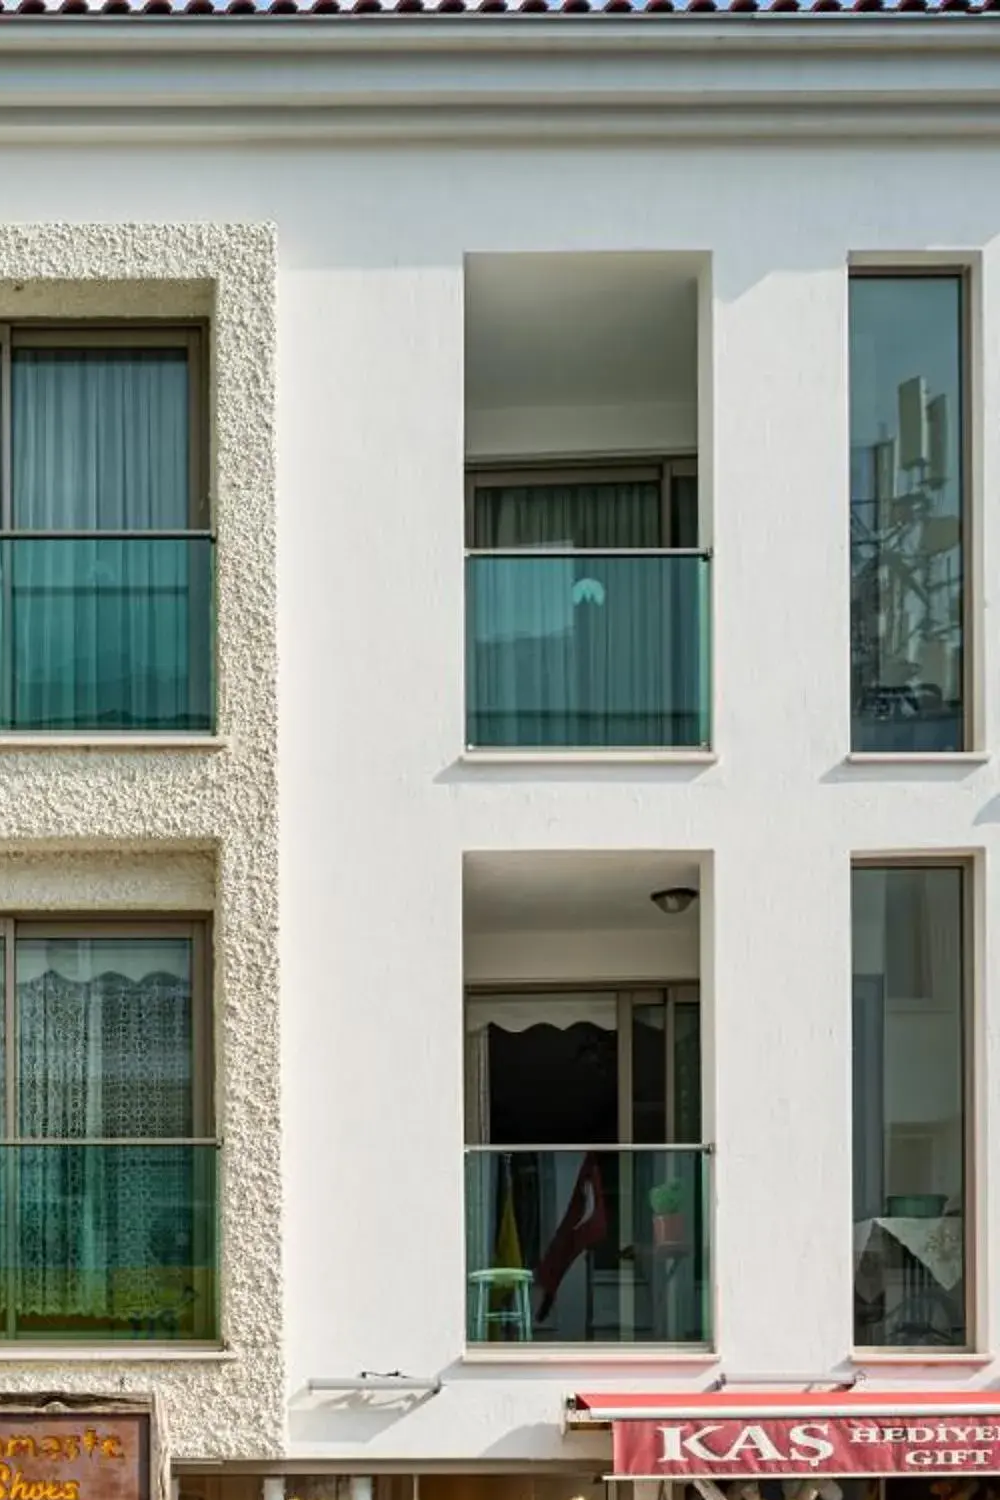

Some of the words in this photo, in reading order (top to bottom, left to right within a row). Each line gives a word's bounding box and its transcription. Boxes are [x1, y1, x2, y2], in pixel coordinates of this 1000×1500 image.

[849, 1423, 1000, 1443] HEDİYE
[656, 1423, 835, 1467] KAŞ
[905, 1449, 993, 1466] GIFT
